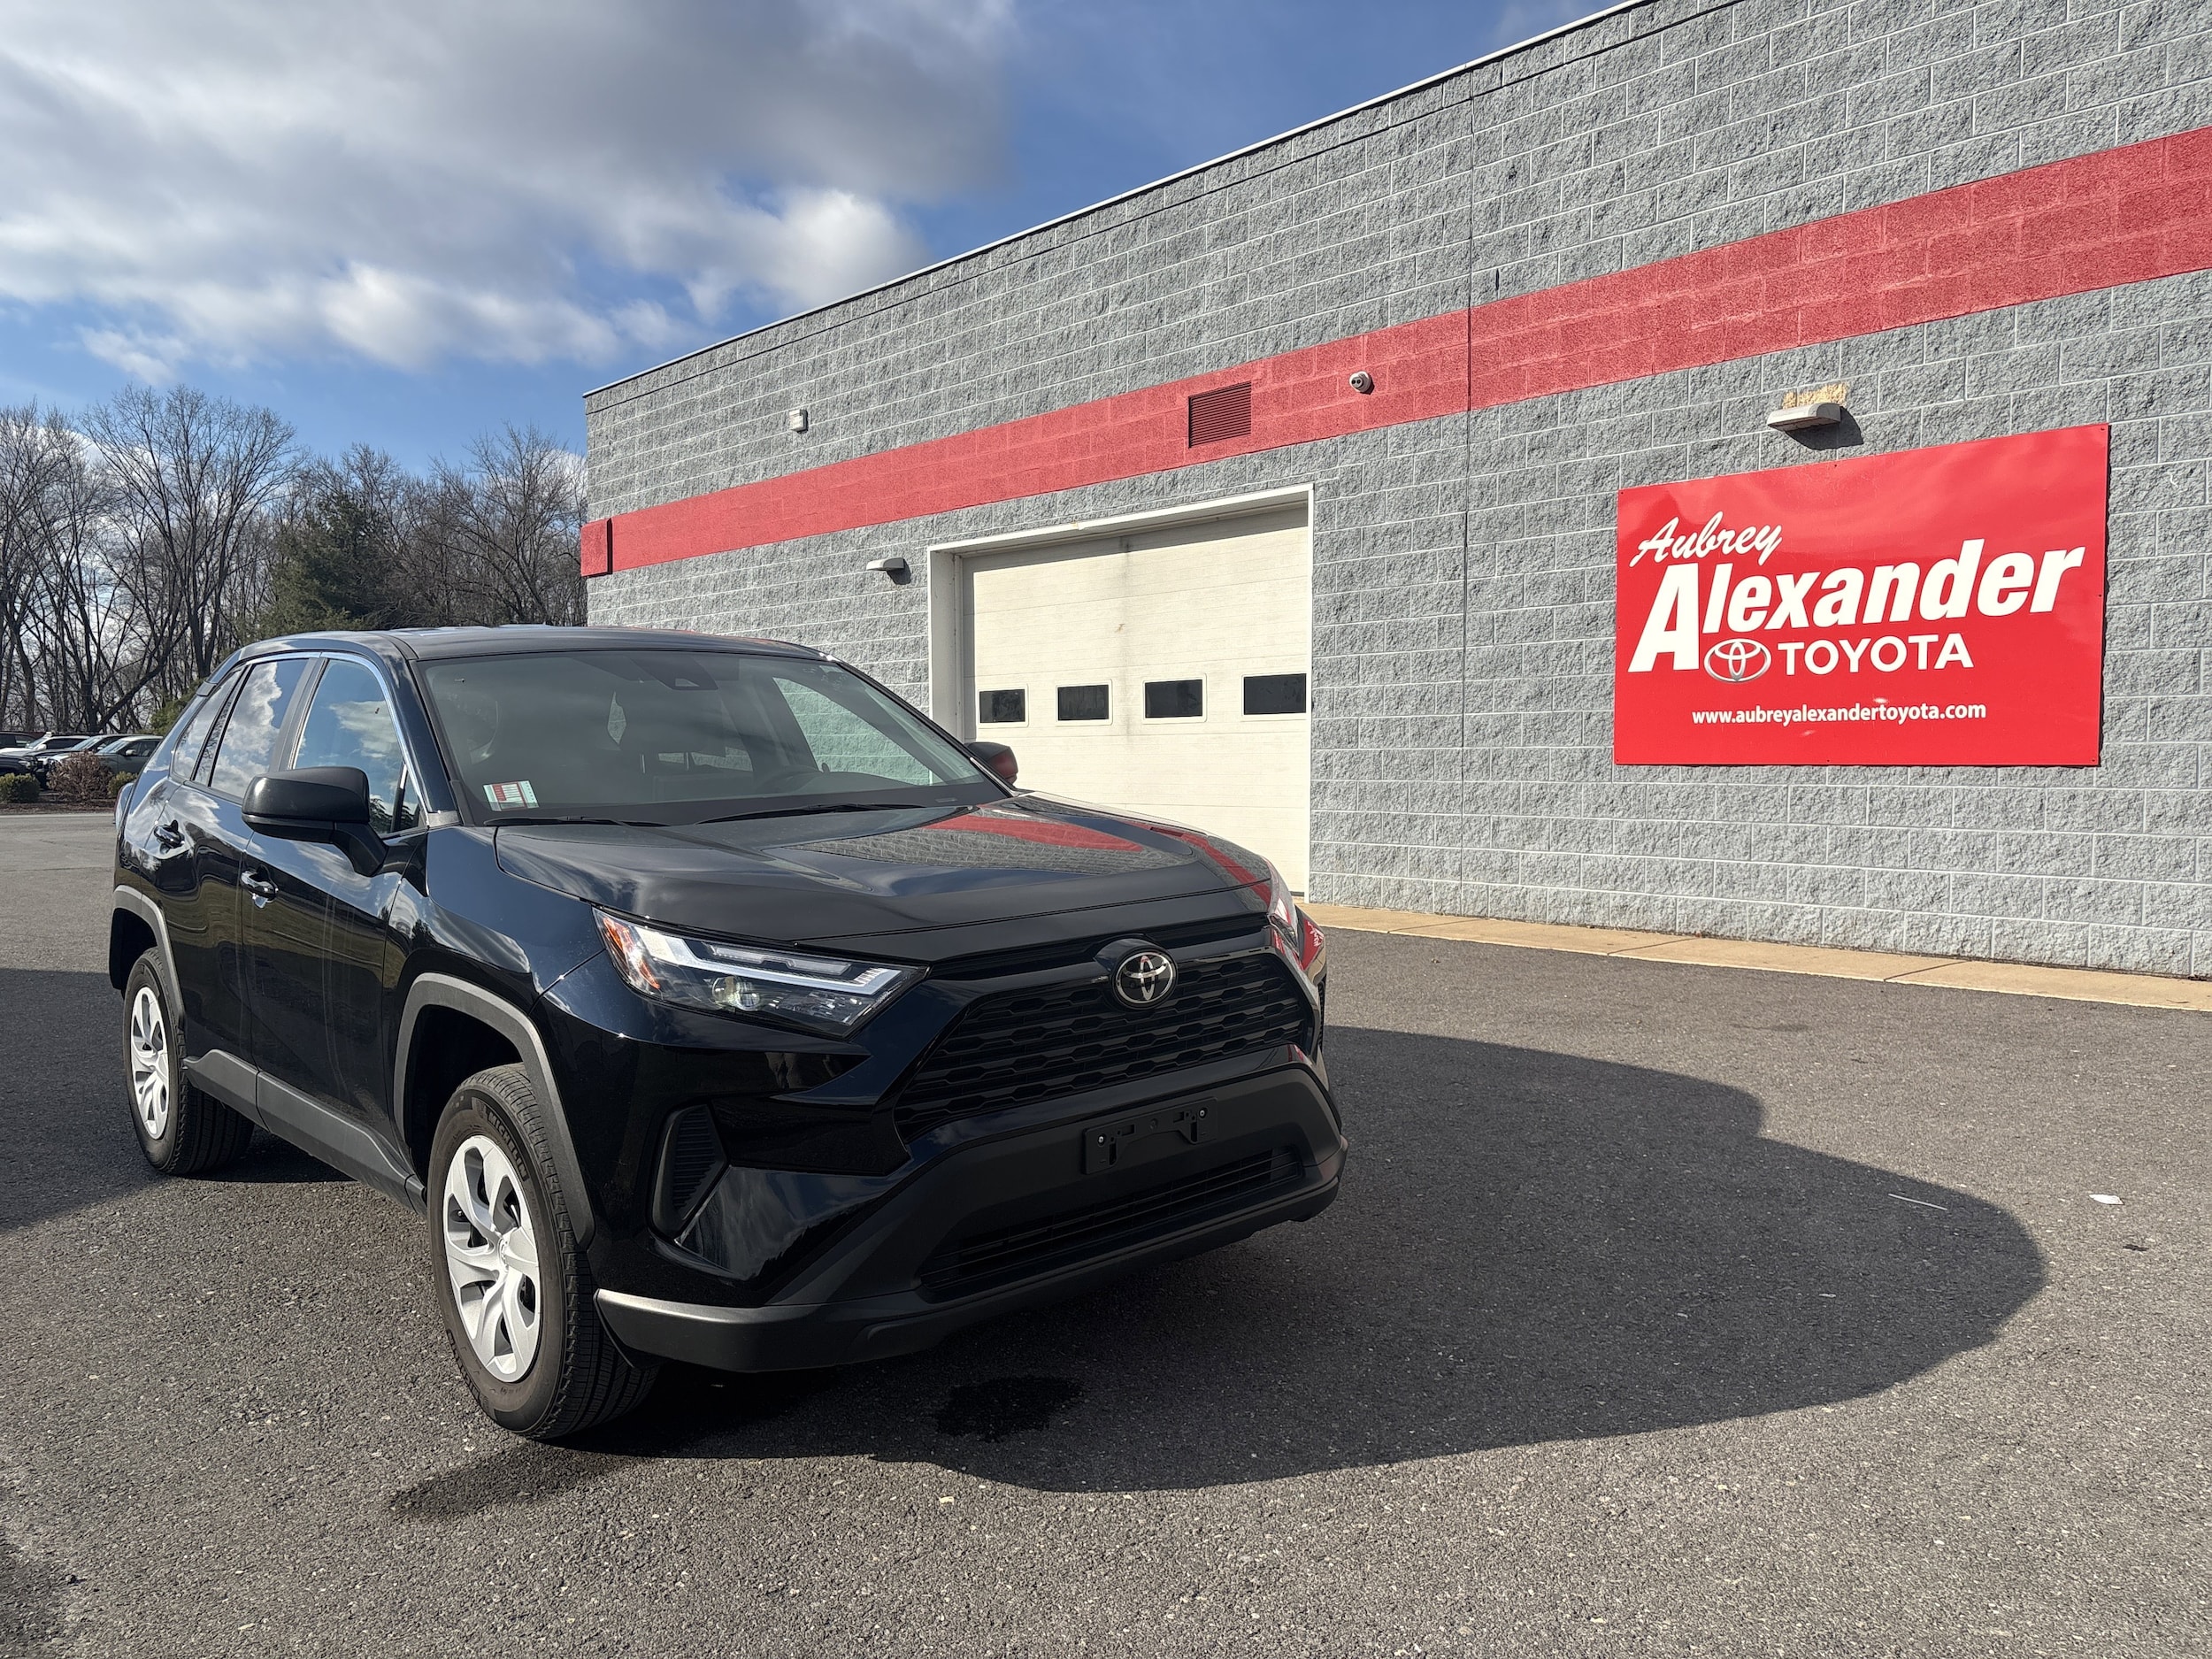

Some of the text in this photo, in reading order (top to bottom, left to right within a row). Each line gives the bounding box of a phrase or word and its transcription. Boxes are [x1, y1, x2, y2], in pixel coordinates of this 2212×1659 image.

[1629, 511, 1783, 567] Aubrey
[1627, 538, 2086, 673] Alexander
[1777, 633, 1974, 676] TOYOTA
[1691, 702, 1987, 726] www.aubreyalexandertoyota.com
[488, 1112, 528, 1179] MICHELIN
